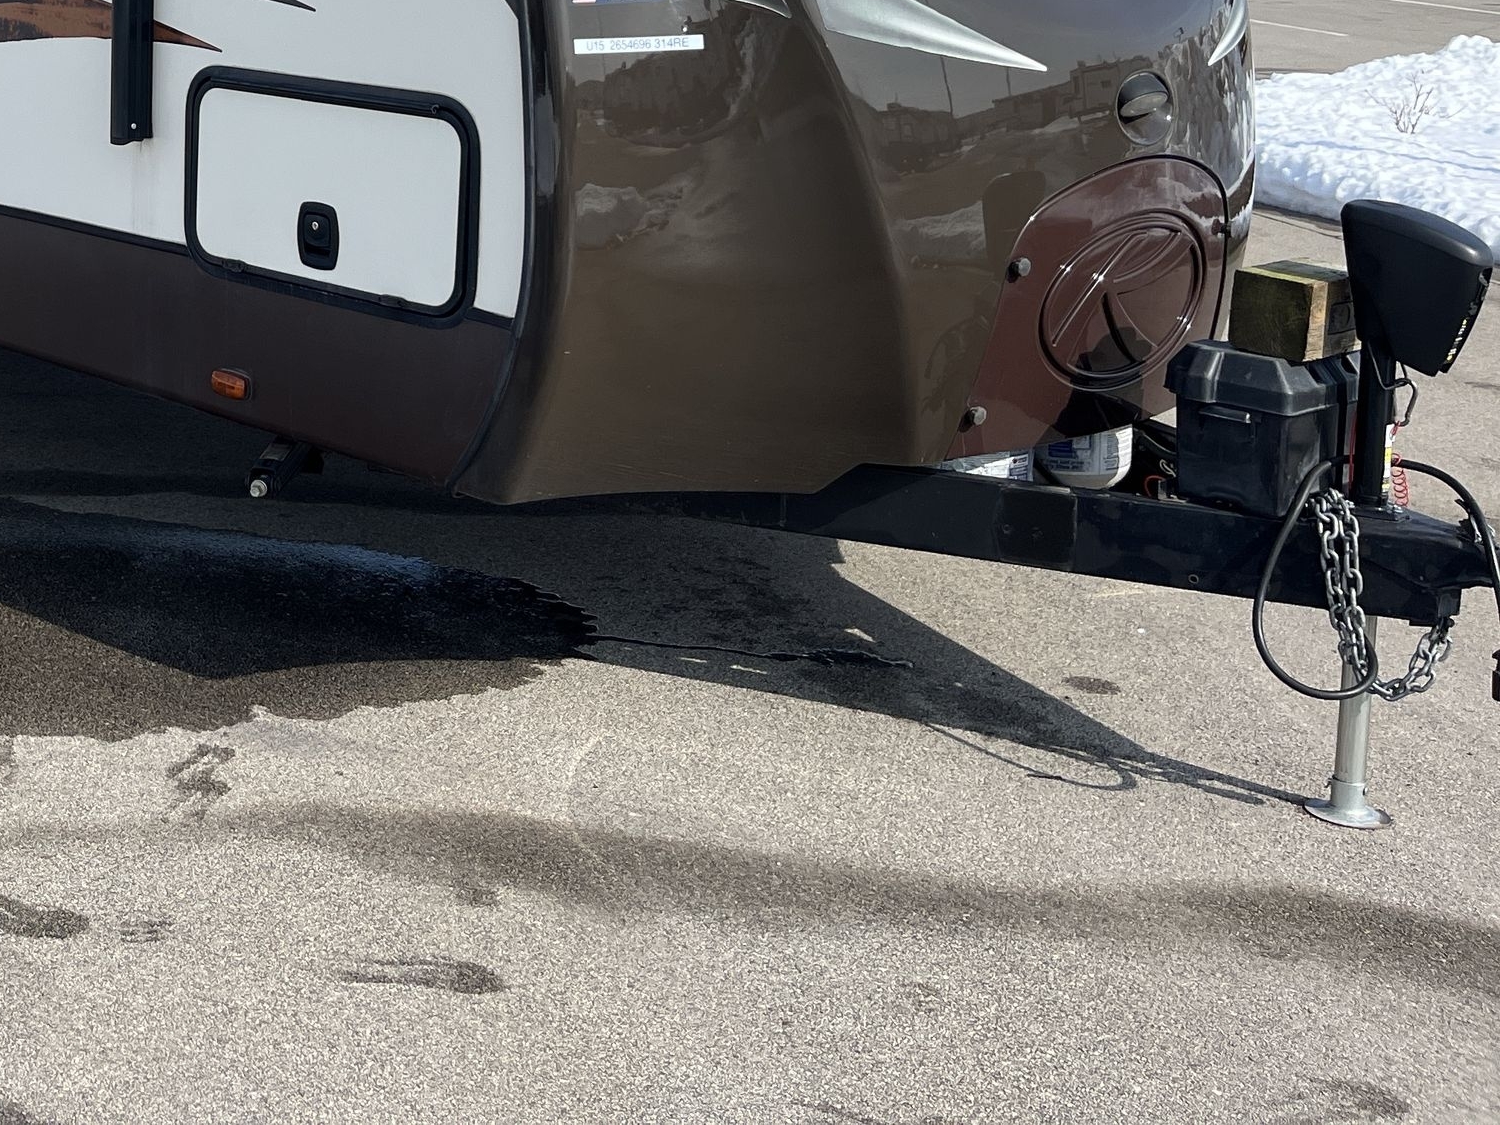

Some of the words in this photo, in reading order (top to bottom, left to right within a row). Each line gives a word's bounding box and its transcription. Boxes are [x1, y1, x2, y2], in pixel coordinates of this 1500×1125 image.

[586, 40, 605, 52] U15
[609, 39, 652, 51] 2654696
[654, 37, 690, 49] 314RE
